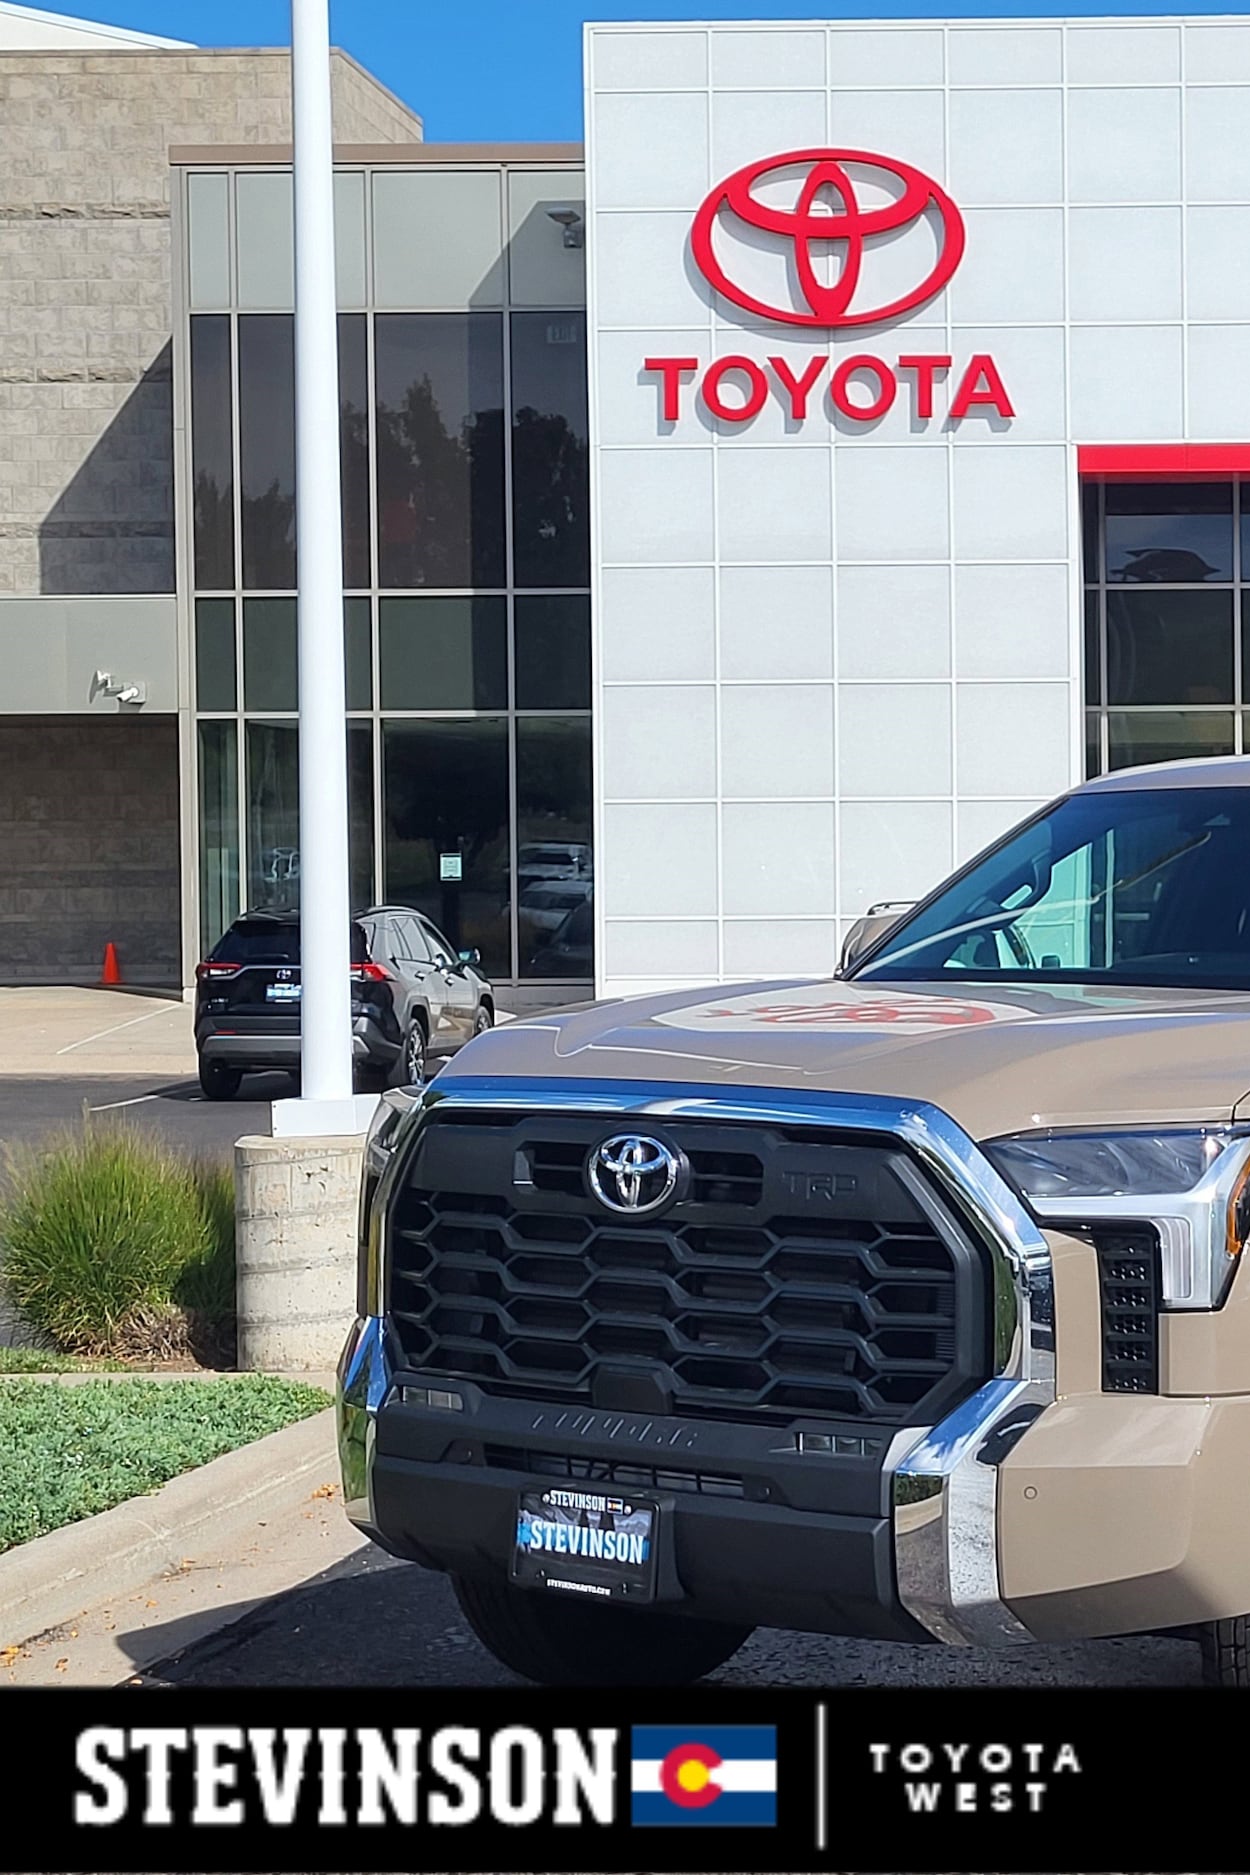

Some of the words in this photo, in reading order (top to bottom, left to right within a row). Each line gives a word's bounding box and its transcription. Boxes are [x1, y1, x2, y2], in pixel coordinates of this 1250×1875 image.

[645, 354, 1016, 422] TOYOTA
[782, 1170, 857, 1200] TRD
[550, 1490, 606, 1512] STEVINSON
[530, 1520, 644, 1565] STEVINSON
